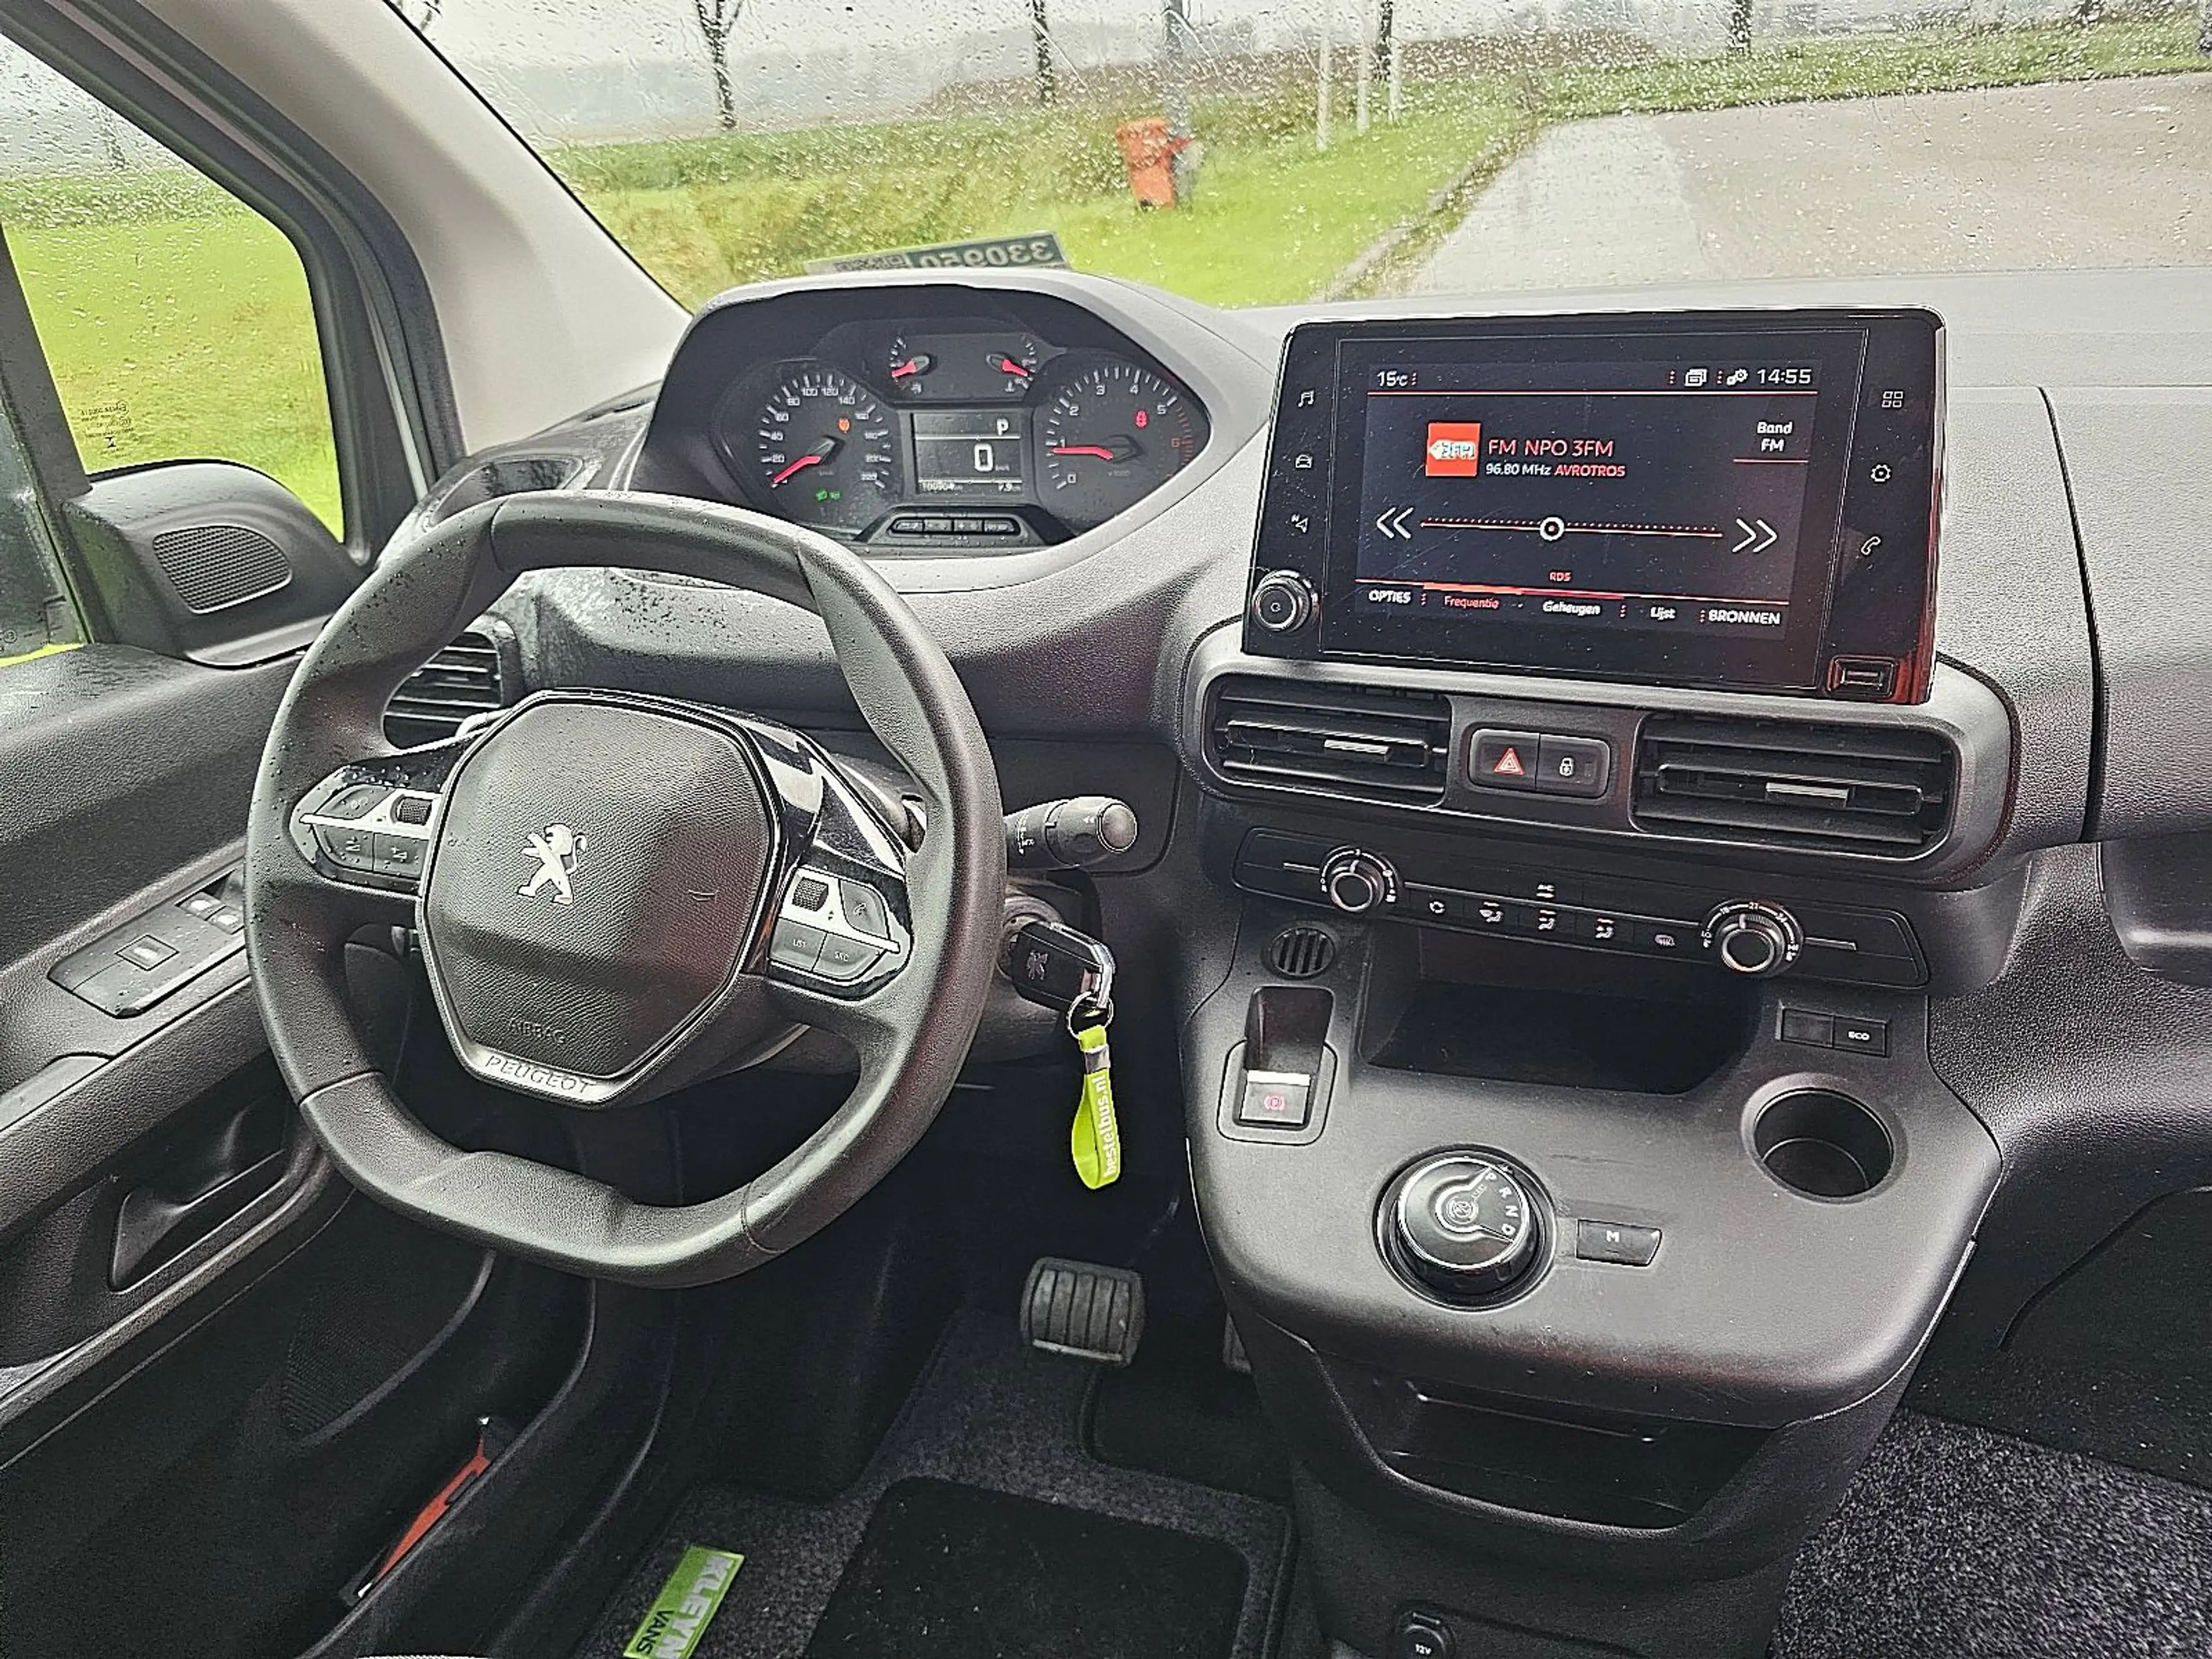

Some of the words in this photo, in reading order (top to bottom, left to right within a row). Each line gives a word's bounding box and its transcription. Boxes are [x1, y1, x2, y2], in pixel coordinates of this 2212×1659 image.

[1756, 369, 1812, 384] 14:55
[1096, 384, 1106, 395] 3
[1129, 384, 1139, 395] 4
[1069, 406, 1079, 416] 2
[1157, 404, 1166, 414] 5
[996, 418, 1009, 436] P
[1756, 421, 1793, 434] Band
[1488, 439, 1517, 456] FM
[1524, 439, 1567, 457] NPO
[1571, 440, 1614, 457] 3FM
[1760, 438, 1785, 452] FM
[974, 443, 994, 472] 0
[1485, 463, 1520, 476] 96.80
[1521, 464, 1551, 476] MHz
[1554, 464, 1626, 477] AVROTROS
[1067, 474, 1077, 484] 0
[1548, 571, 1572, 582] RDS
[1368, 590, 1412, 604] OPTIES
[1444, 596, 1500, 609] Frequentie
[1543, 600, 1601, 616] Geheugen
[1707, 609, 1782, 626] BRONNEN
[485, 1055, 596, 1093] PEUGEOT
[1484, 1172, 1497, 1181] P
[1498, 1187, 1513, 1199] R
[1505, 1205, 1519, 1218] N
[1606, 1230, 1620, 1243] M
[636, 1610, 675, 1655] VANS
